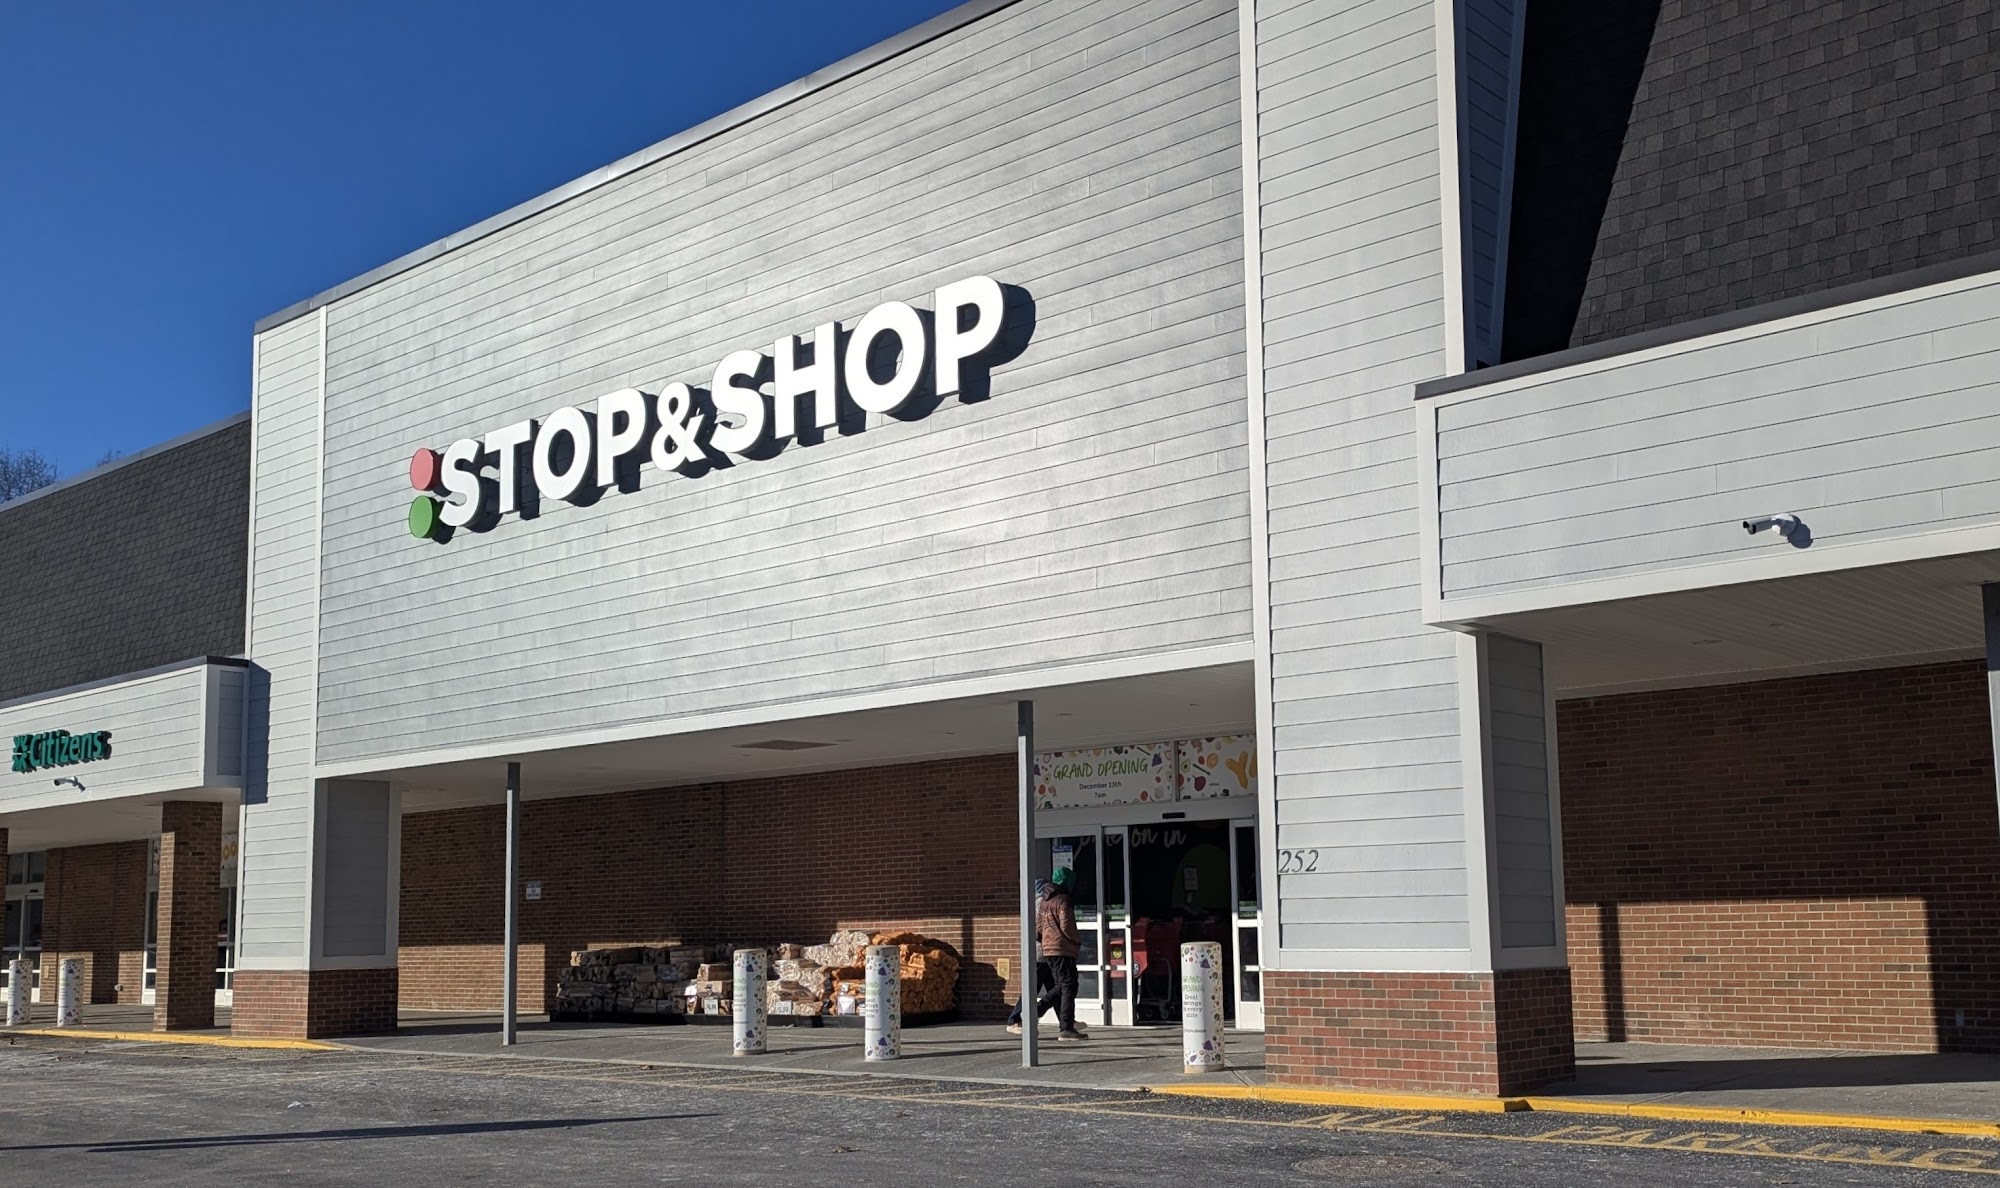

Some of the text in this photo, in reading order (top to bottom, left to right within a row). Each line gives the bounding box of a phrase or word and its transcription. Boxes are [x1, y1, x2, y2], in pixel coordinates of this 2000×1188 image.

[29, 730, 107, 767] Citizens
[1053, 758, 1148, 780] GRAND OPENING
[1279, 849, 1319, 873] 252
